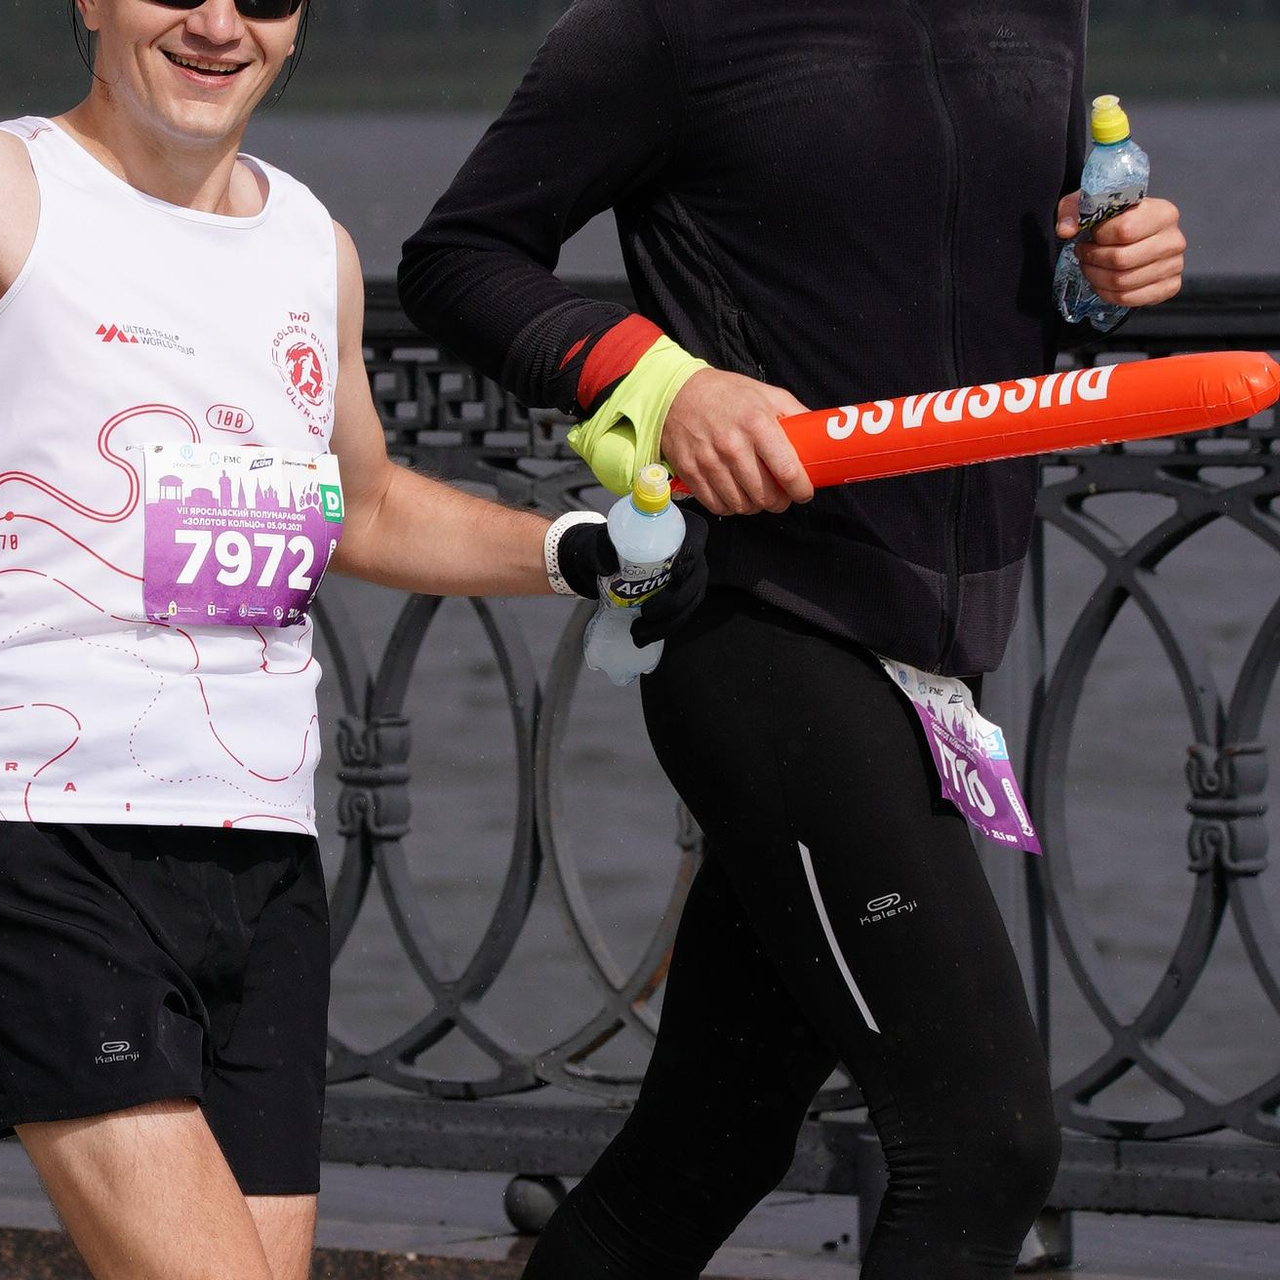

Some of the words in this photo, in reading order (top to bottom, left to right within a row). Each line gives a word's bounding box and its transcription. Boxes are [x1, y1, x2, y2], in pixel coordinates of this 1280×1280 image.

[272, 325, 307, 347] GOLDEN
[216, 409, 244, 429] 100
[325, 490, 340, 511] D
[176, 506, 188, 515] VII
[189, 506, 249, 518] ЯРОСЛАВСКИЙ
[250, 510, 306, 522] ПОЛУМАРАФОН
[182, 516, 227, 527] «ЗОЛОТОЕ
[228, 518, 265, 529] КОЛЬЦО»
[266, 521, 302, 531] 05.09.2021
[0, 534, 18, 550] 70
[174, 529, 315, 590] 7972
[859, 899, 918, 926] Kalenji
[94, 1050, 140, 1065] Kalenji
